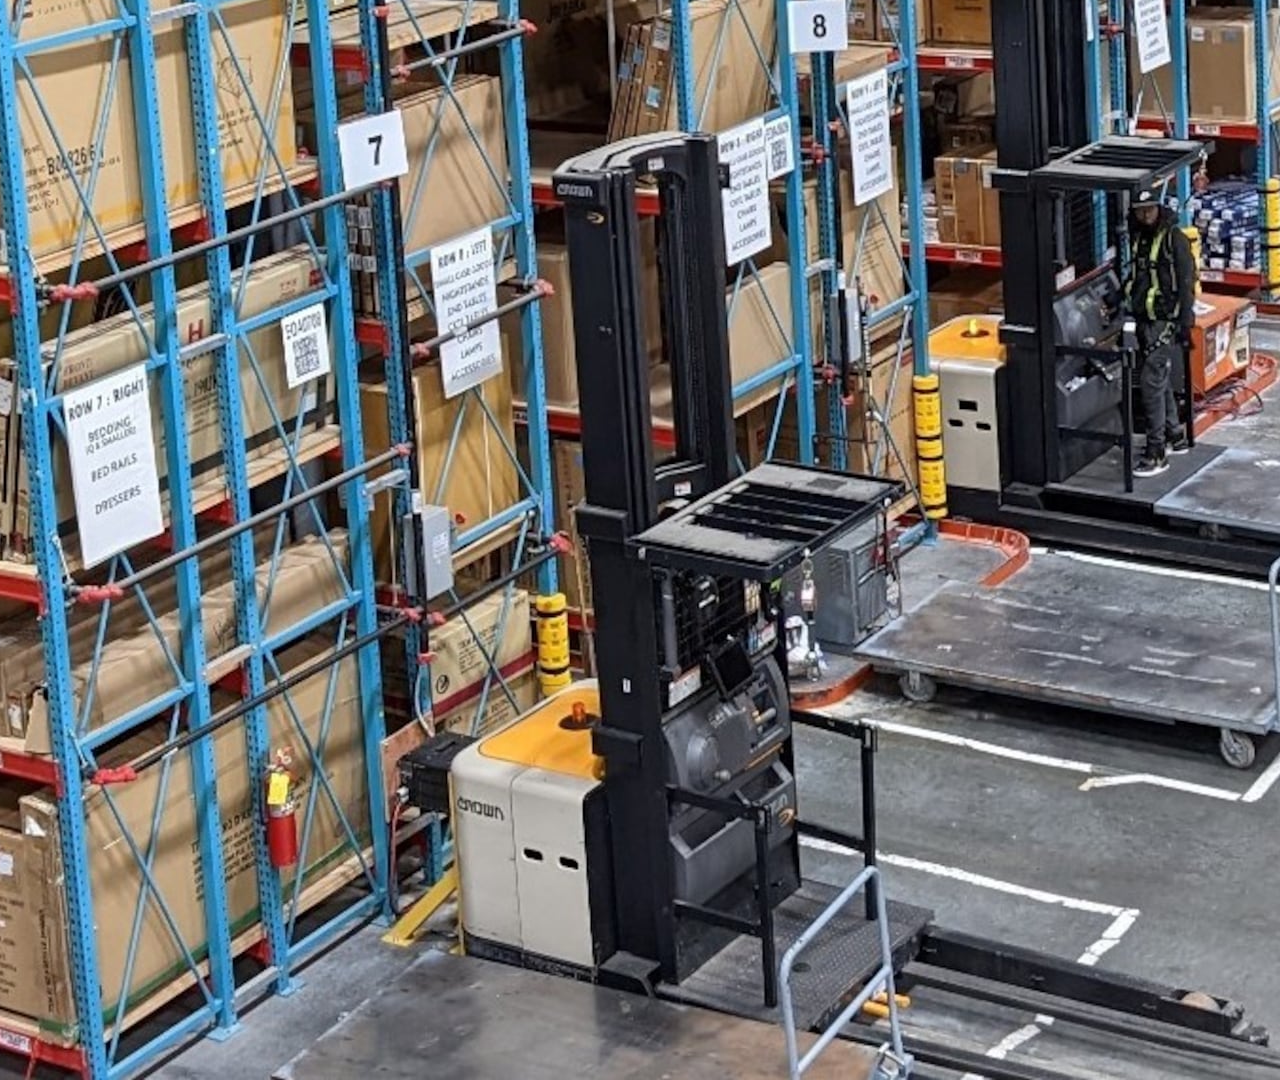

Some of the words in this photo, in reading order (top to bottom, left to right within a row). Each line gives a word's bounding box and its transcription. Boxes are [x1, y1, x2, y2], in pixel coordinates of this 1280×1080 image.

[813, 14, 827, 38] 8
[368, 135, 383, 166] 7
[69, 398, 93, 422] ROW
[113, 378, 145, 404] RIGHT
